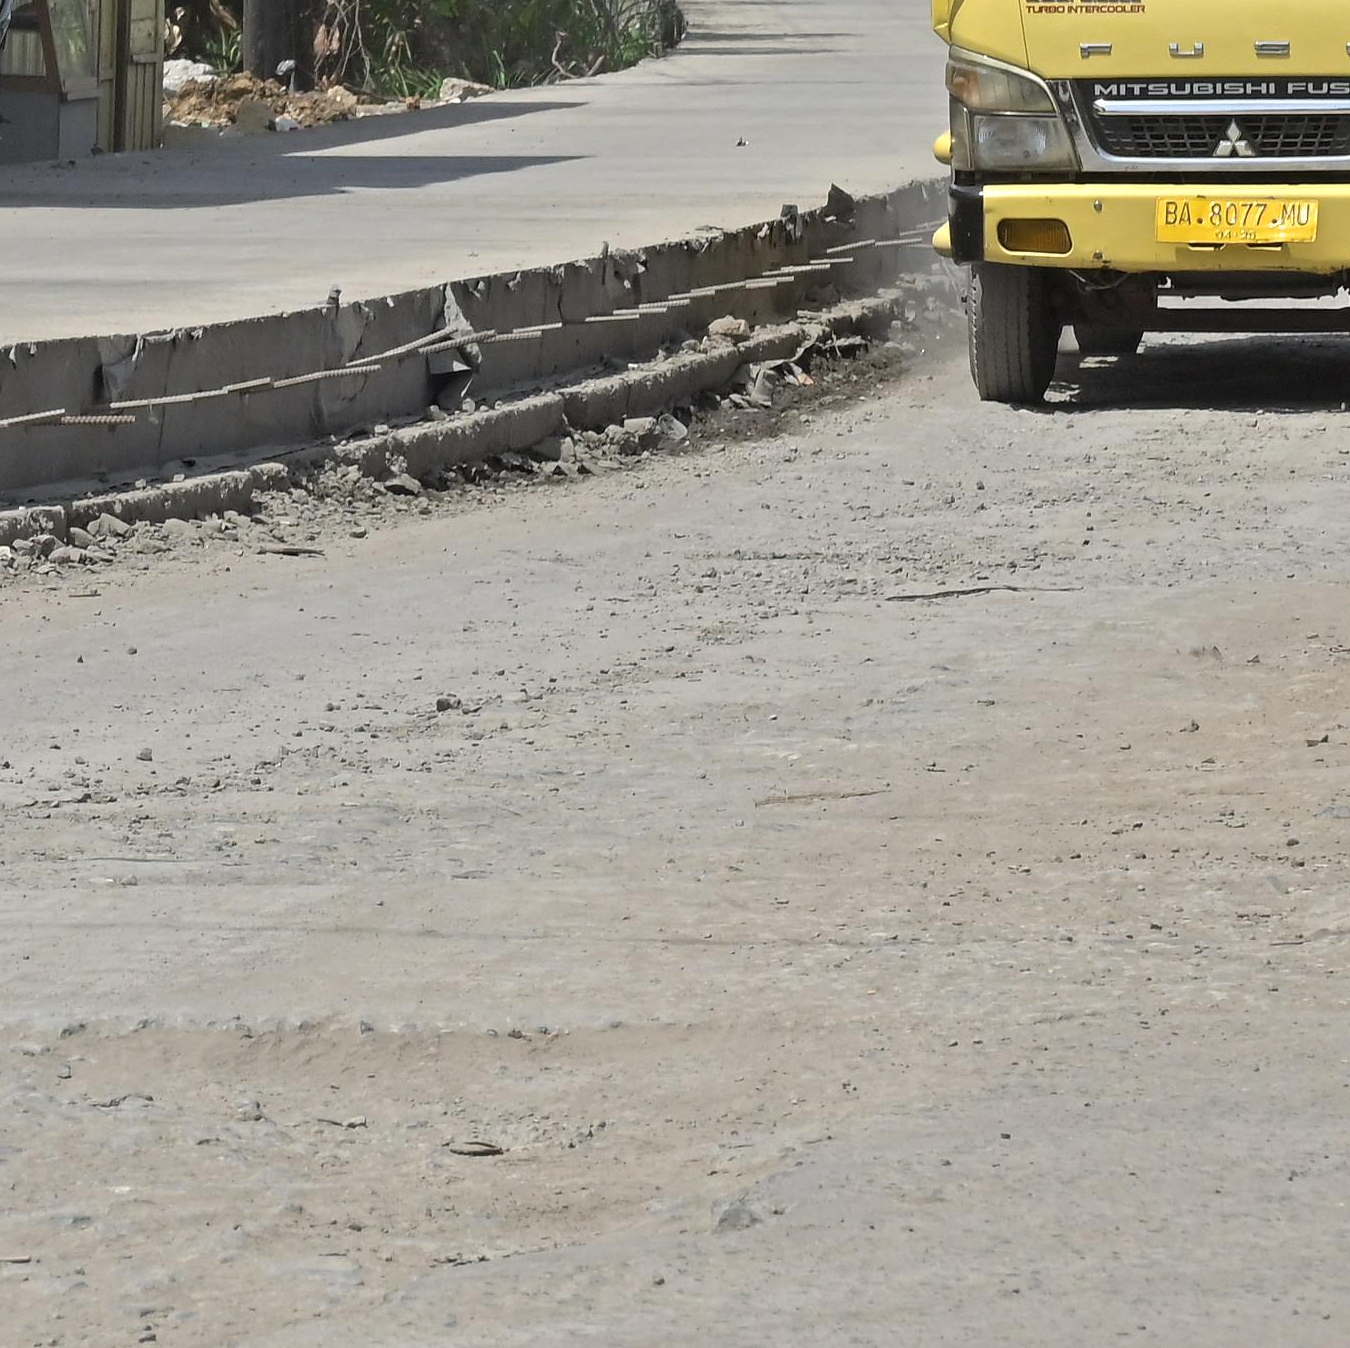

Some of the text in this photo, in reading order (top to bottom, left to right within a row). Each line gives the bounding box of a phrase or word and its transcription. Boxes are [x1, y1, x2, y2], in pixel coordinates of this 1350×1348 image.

[1025, 4, 1146, 14] TURBO INTERCOOLER
[1094, 83, 1276, 96] MITSUBISHI
[1164, 201, 1311, 227] BA 8077 MU
